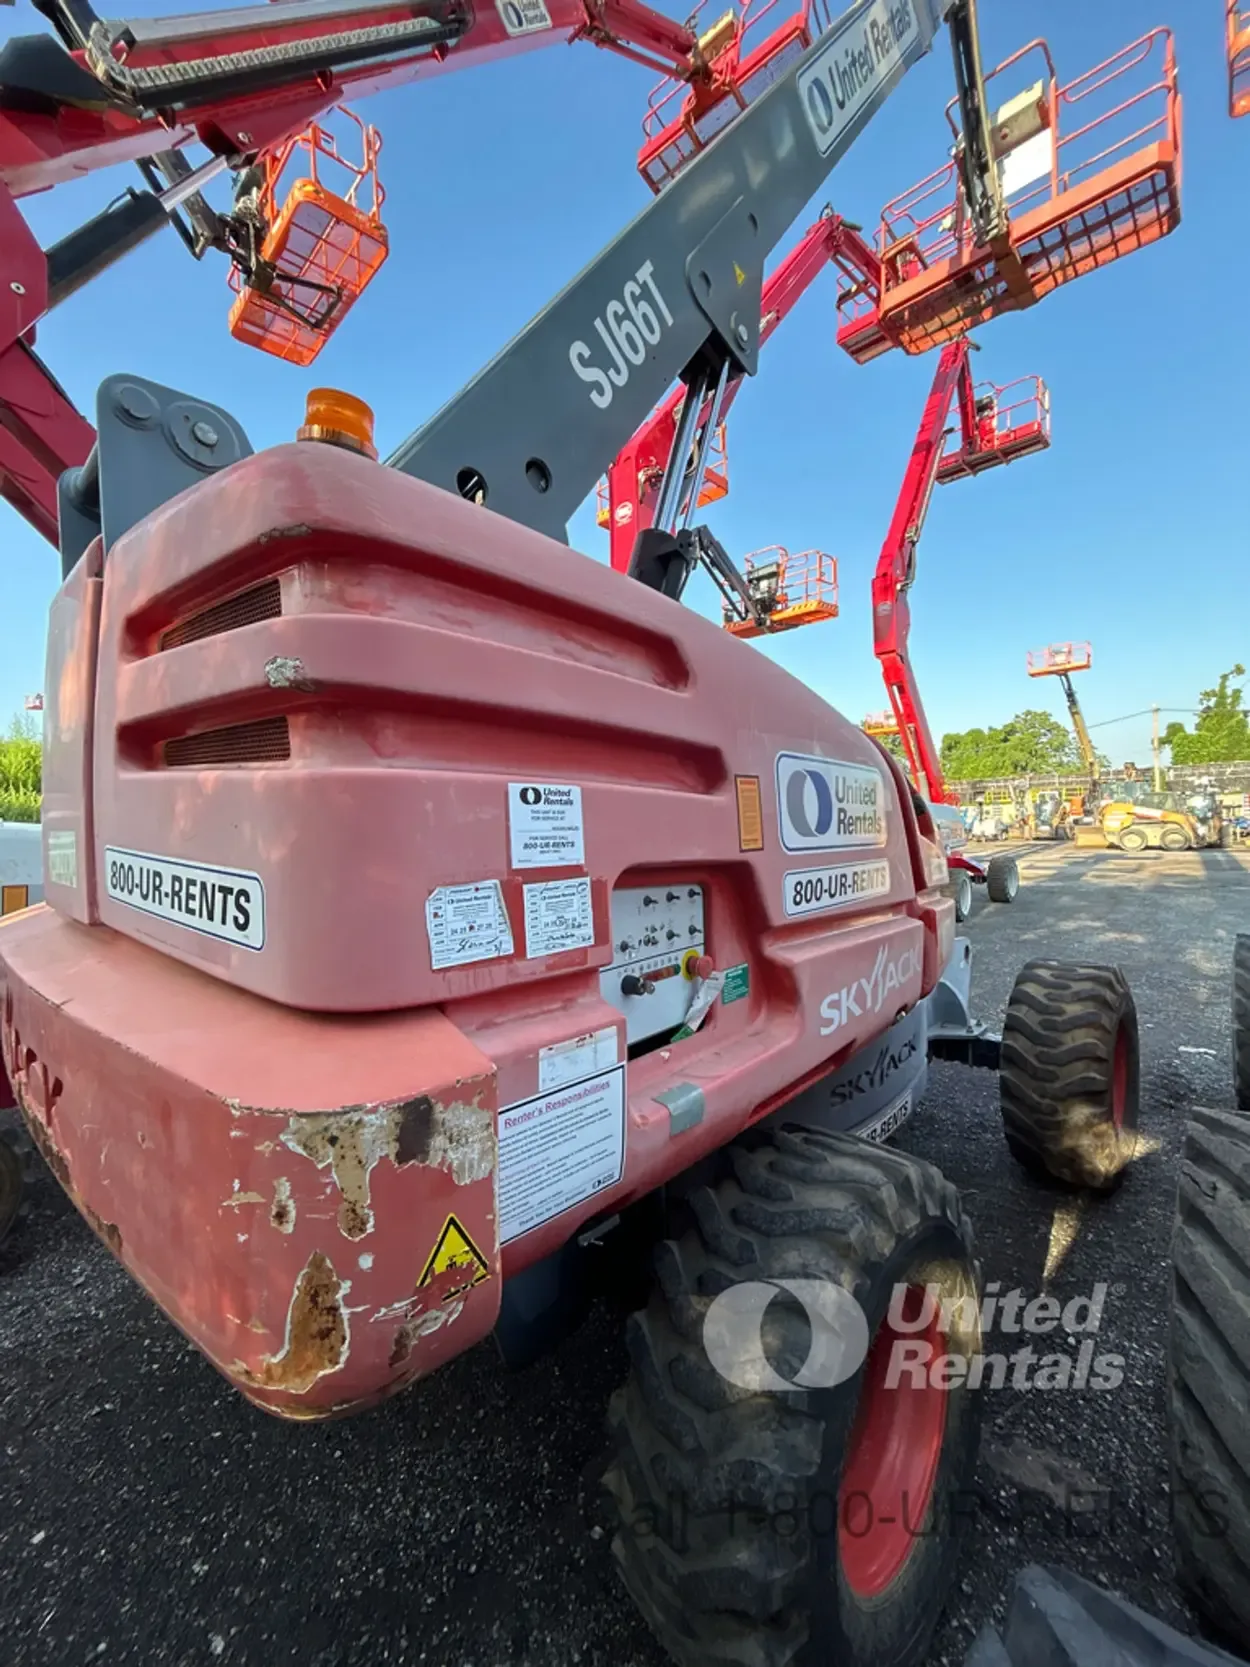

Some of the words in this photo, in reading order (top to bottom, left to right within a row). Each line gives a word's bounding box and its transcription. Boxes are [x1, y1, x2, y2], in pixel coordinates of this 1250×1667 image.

[828, 28, 875, 110] United
[869, 0, 912, 64] Rentals
[569, 259, 675, 408] SJ66T
[543, 787, 572, 797] United
[543, 797, 574, 806] Rentals
[834, 776, 877, 804] United
[837, 808, 882, 836] Rentals
[522, 841, 575, 850] 800-UR-RENTS
[110, 860, 251, 932] 800-UR-RENTS
[792, 866, 887, 906] 800-UR-RENTS
[820, 943, 923, 1036] SKYJACK
[830, 1034, 918, 1108] SKYJACK
[504, 1107, 543, 1130] Renter's
[545, 1079, 610, 1113] Responsibilities
